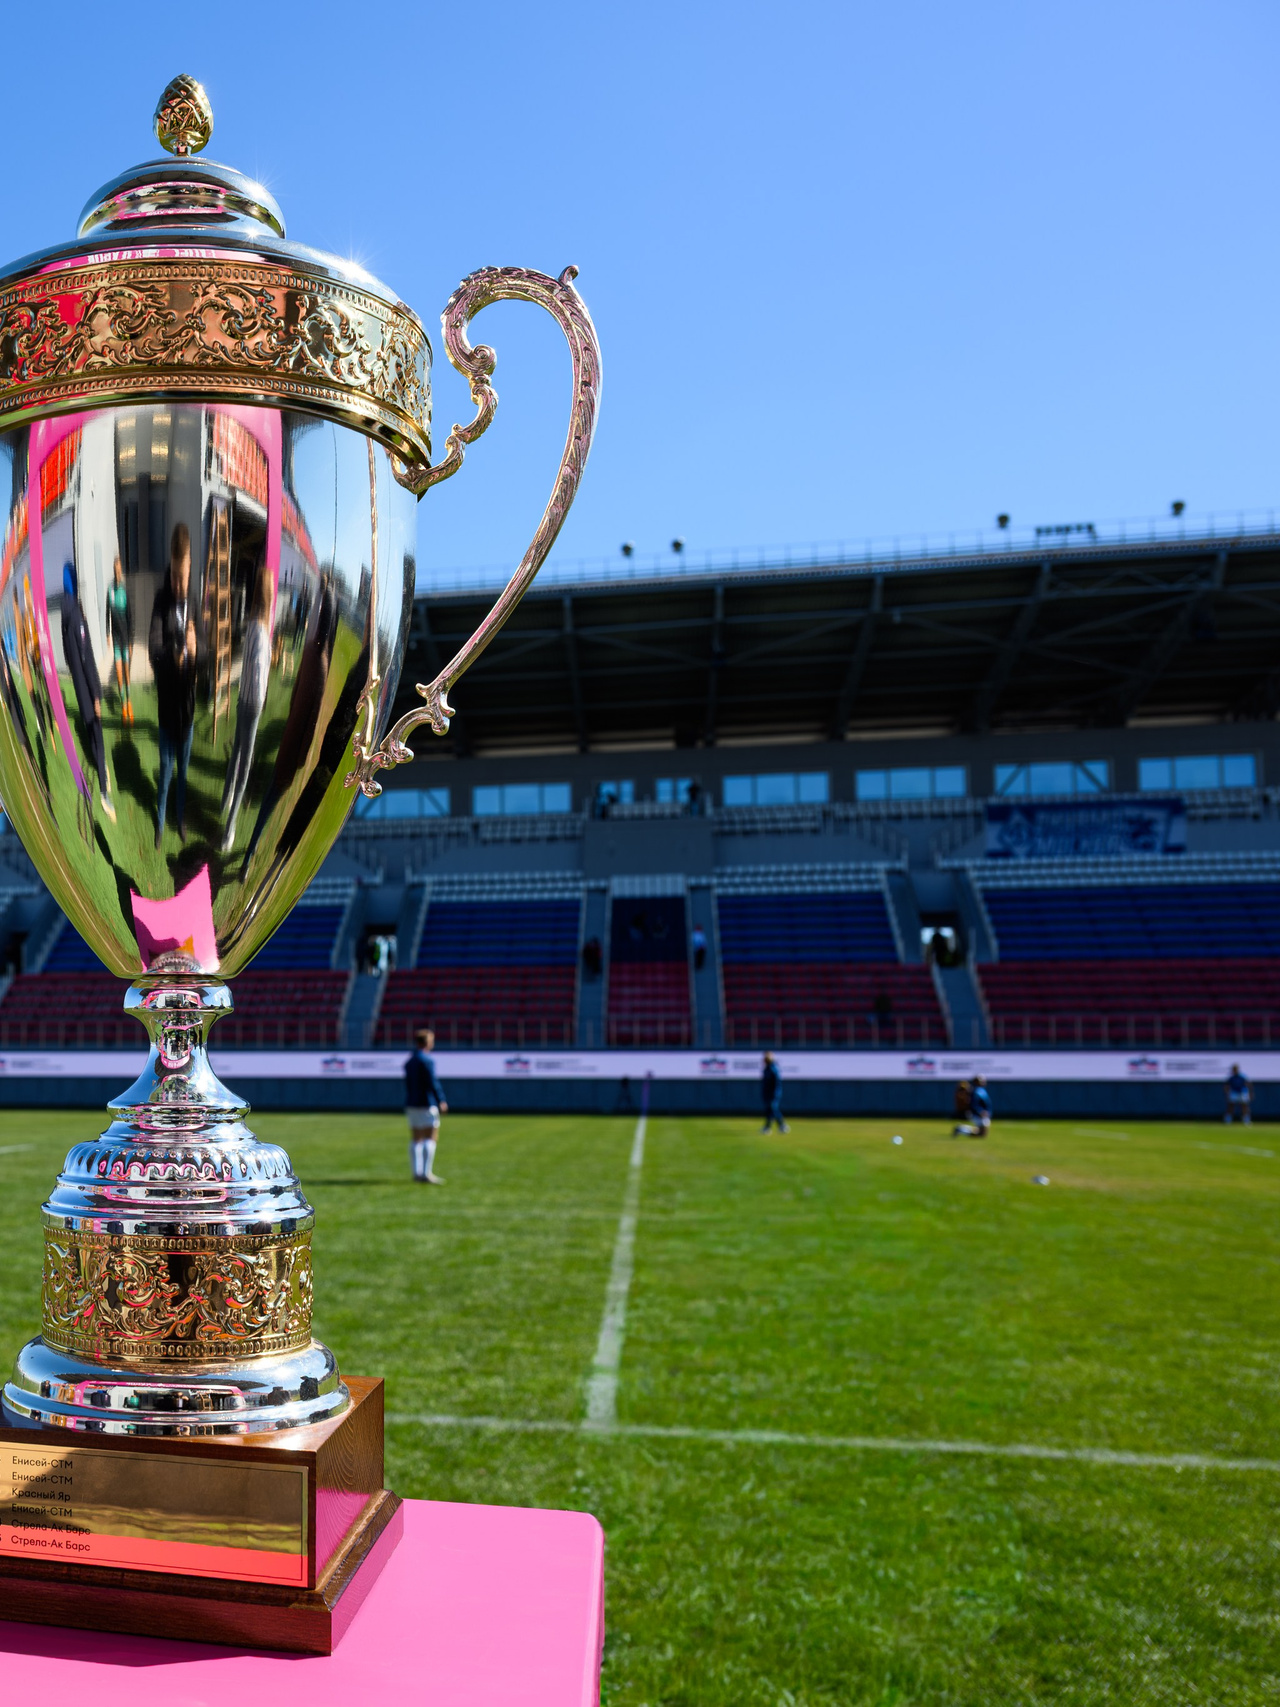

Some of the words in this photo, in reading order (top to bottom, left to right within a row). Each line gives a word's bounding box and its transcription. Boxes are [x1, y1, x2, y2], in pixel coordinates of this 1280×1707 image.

[12, 1456, 73, 1469] Енисей-СТМ
[12, 1472, 73, 1485] Енисей-СТМ
[11, 1487, 55, 1500] Красный
[58, 1492, 71, 1502] Яр
[11, 1503, 72, 1517] Енисей-СТМ
[11, 1519, 63, 1532] Стрела-Ак
[66, 1524, 91, 1536] Барс
[10, 1535, 63, 1548] Стрела-Ак
[65, 1540, 91, 1552] Барс
